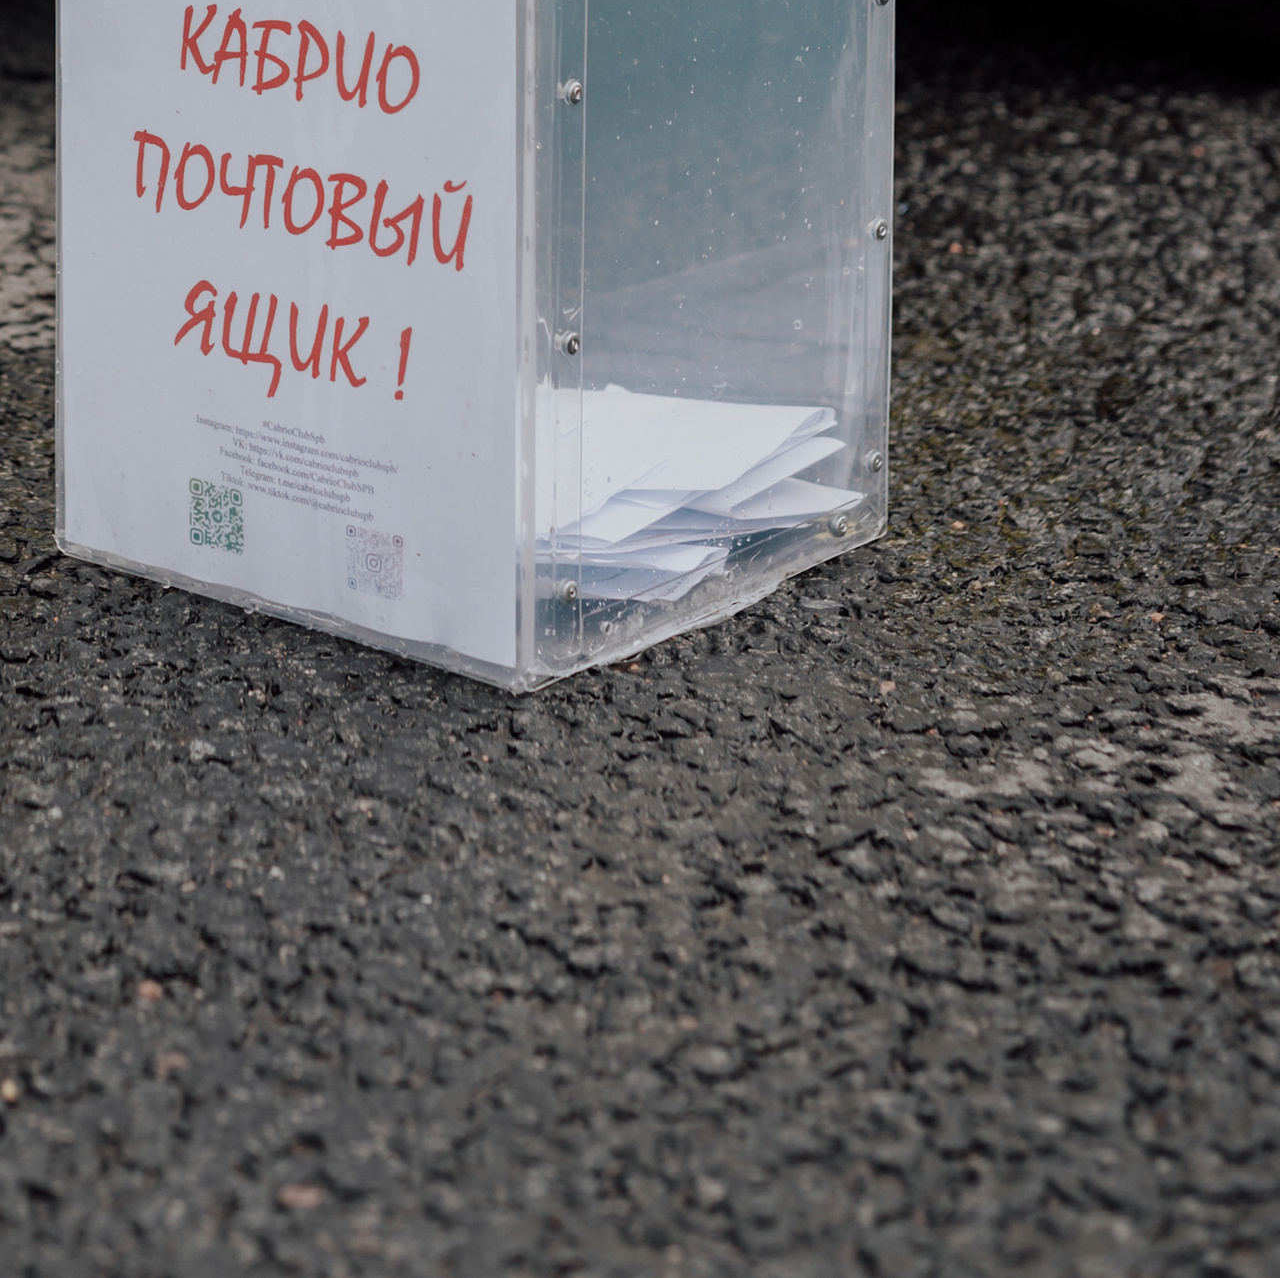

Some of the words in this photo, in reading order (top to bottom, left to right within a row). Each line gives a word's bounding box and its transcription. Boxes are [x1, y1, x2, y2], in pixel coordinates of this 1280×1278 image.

[180, 4, 420, 114] КАБРИО
[133, 130, 473, 272] ПОЧТОВЫЙ
[196, 414, 234, 433] Instagram:
[262, 420, 326, 444] #CabrioClubSpb
[232, 437, 247, 450] VK:
[219, 446, 255, 465] Facebook:
[240, 465, 276, 483] Telegram:
